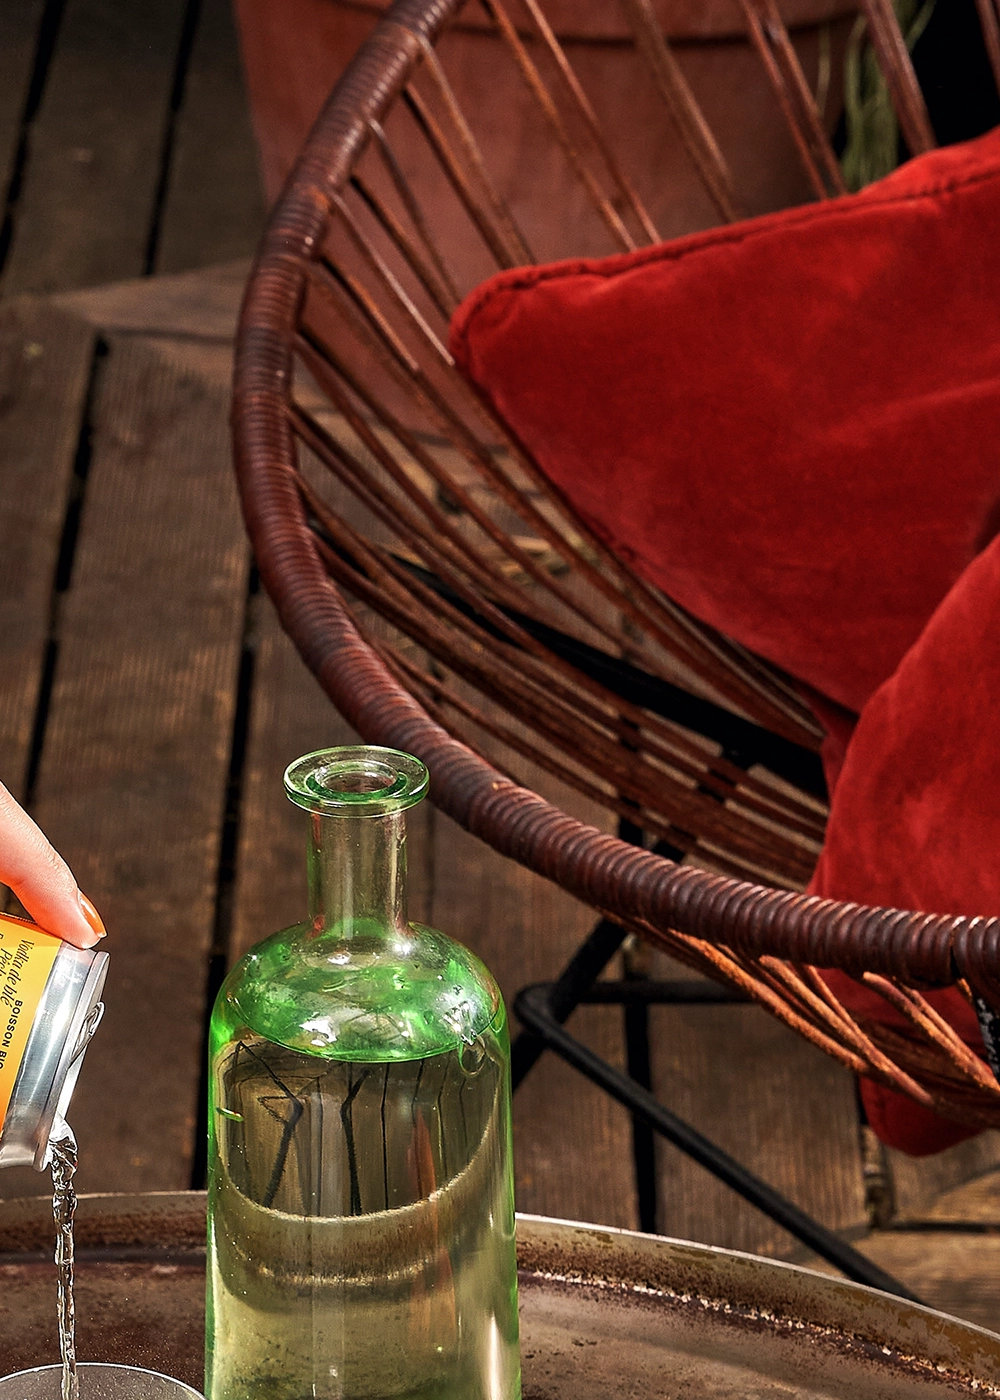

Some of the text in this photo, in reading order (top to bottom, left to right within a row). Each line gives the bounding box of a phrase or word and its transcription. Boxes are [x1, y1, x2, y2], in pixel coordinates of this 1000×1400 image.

[0, 939, 34, 1008] Vodka de blé
[1, 1000, 23, 1047] BOISSON
